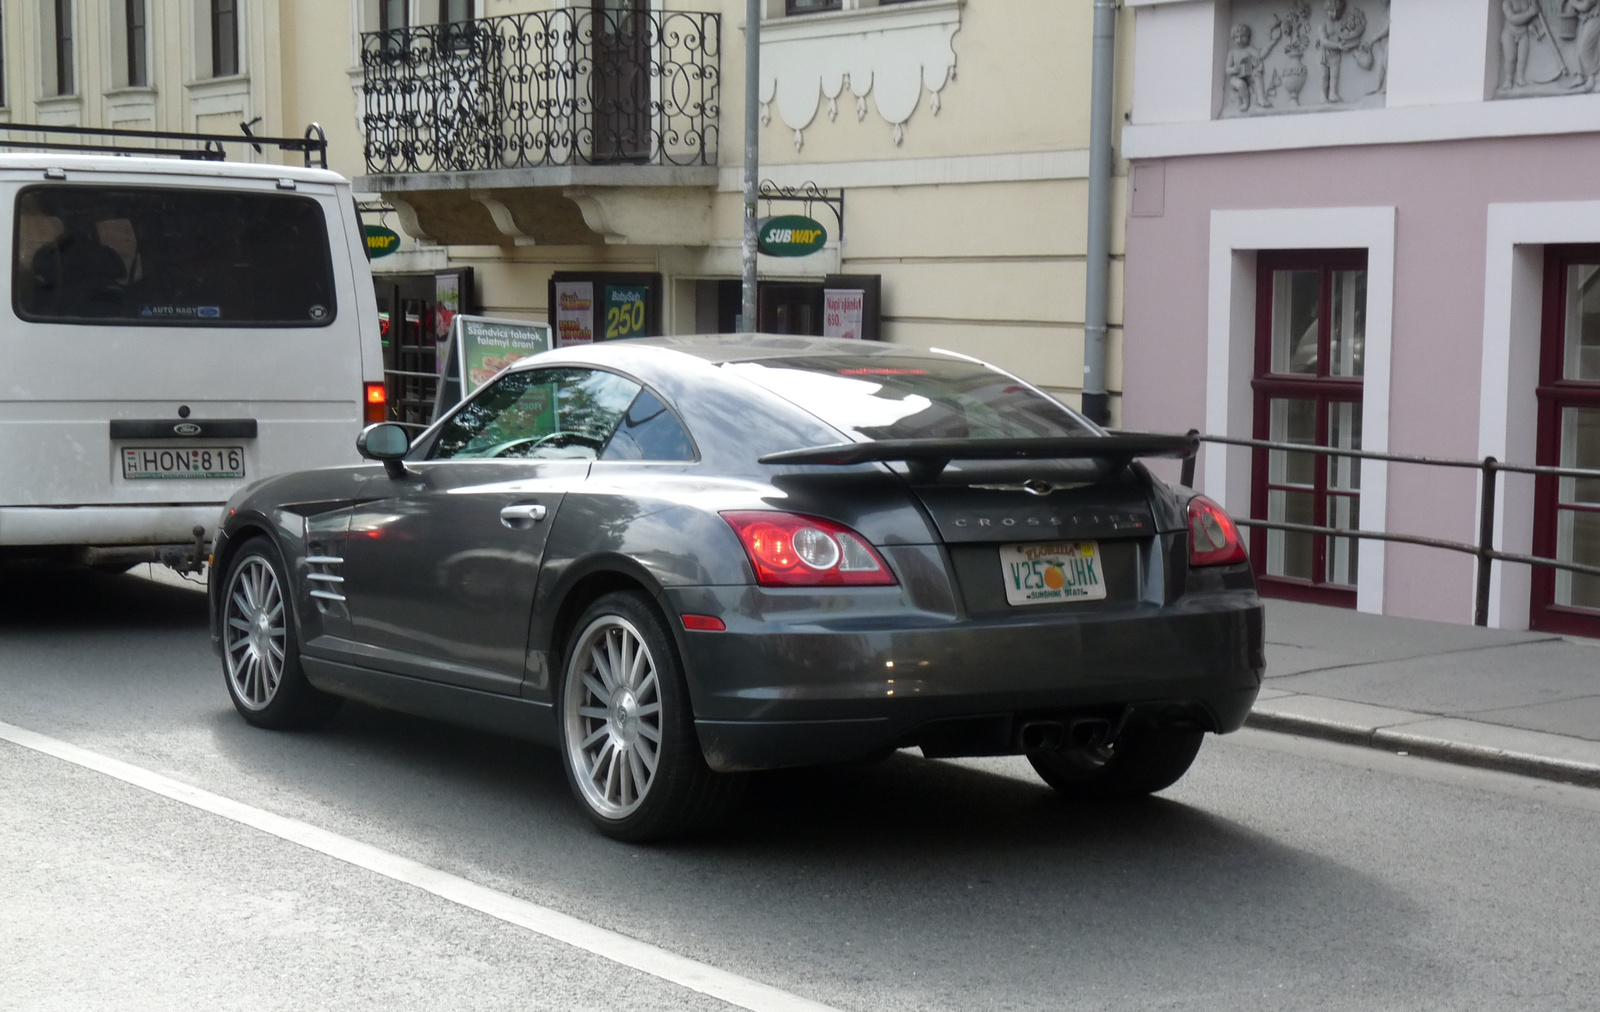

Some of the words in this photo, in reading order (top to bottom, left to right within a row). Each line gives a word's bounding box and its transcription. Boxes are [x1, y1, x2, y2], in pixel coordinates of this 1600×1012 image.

[367, 235, 395, 247] WAY
[765, 228, 822, 243] SUBWAY
[606, 300, 645, 338] 250
[1030, 590, 1062, 599] SUNSHINE
[1064, 588, 1084, 597] STATE
